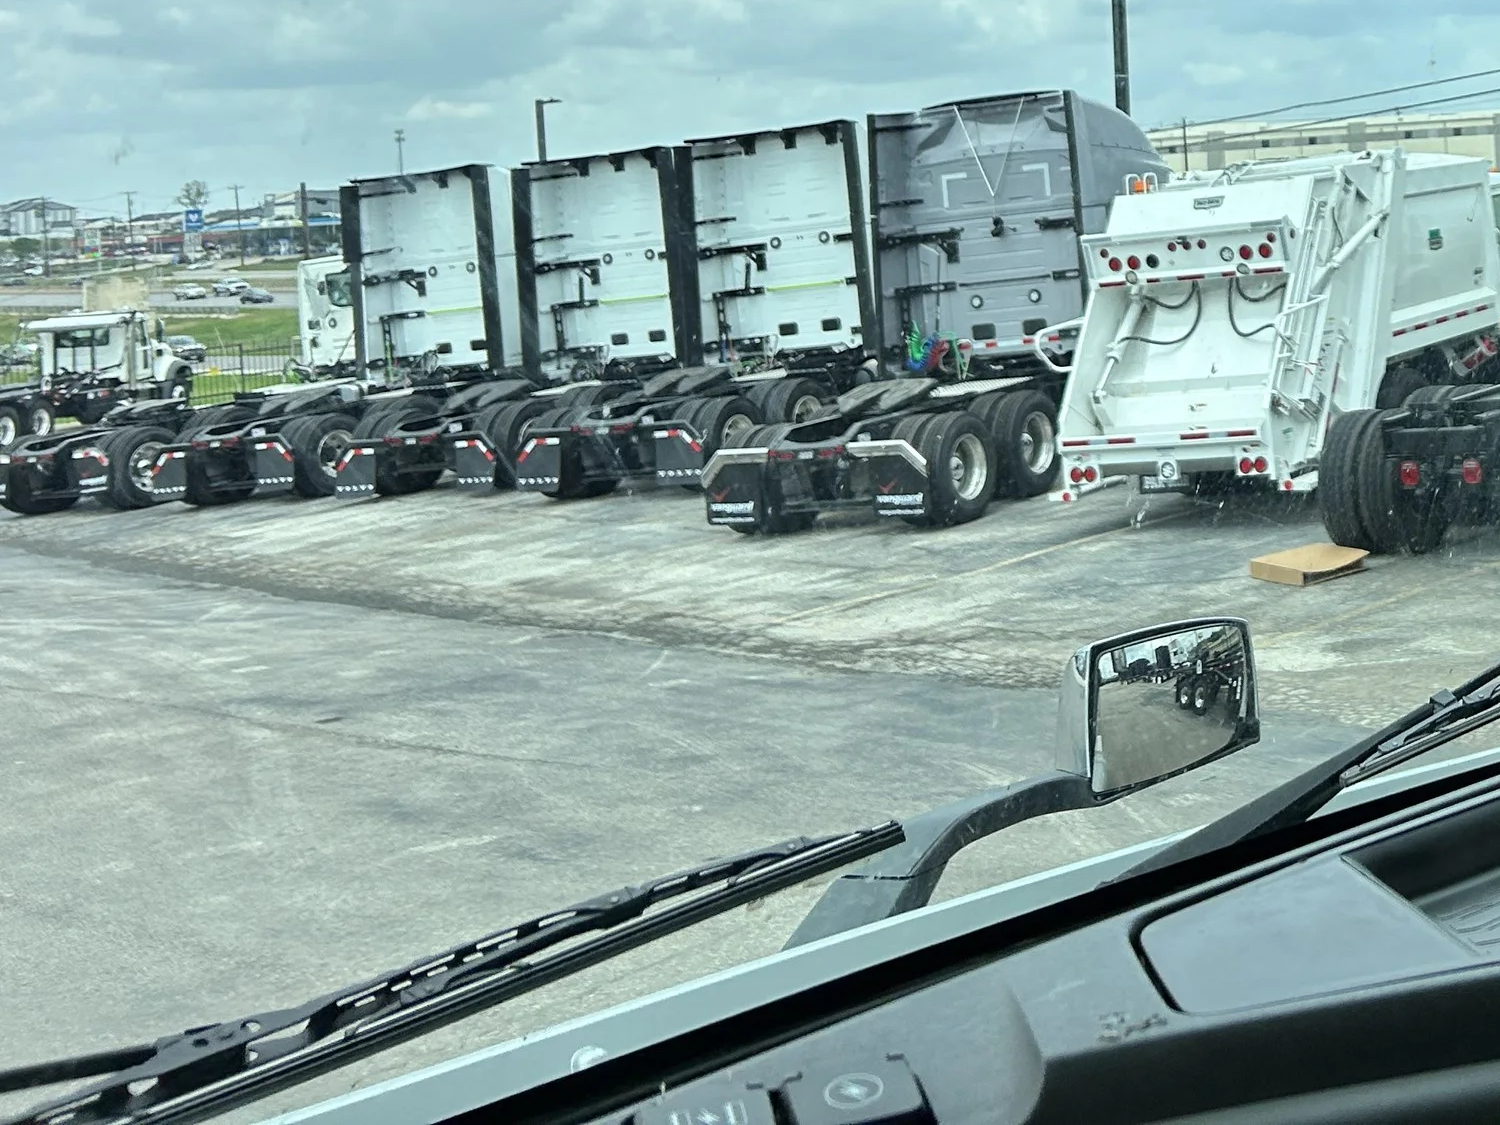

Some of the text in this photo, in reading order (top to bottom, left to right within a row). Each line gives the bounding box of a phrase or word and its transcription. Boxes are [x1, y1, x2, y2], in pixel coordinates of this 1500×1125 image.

[657, 468, 702, 478] VOLVO
[258, 476, 294, 485] VOLVO
[458, 476, 494, 485] VOLVO
[518, 476, 560, 486] VOLVO
[152, 486, 187, 495] VOLVO
[336, 483, 375, 493] VOLVO
